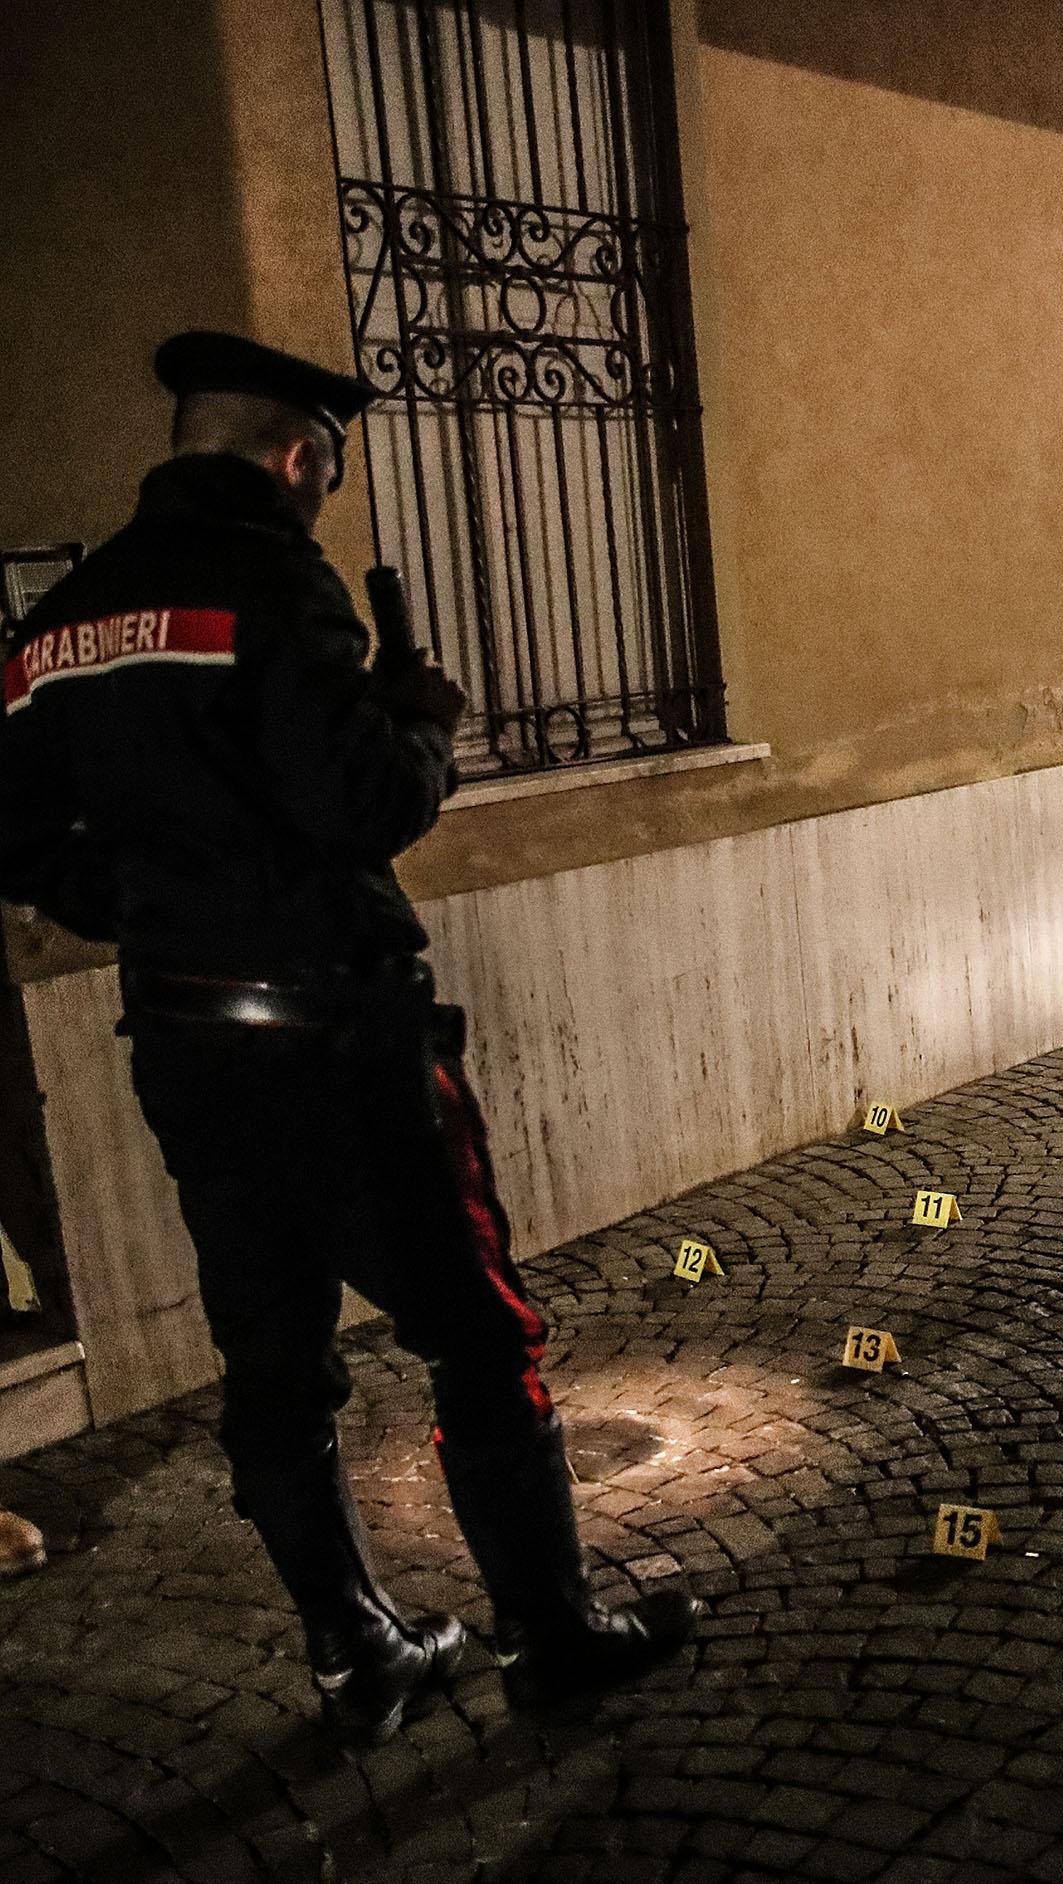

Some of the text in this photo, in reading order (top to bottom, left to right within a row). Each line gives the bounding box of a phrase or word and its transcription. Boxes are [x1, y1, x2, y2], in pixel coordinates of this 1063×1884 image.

[871, 1106, 887, 1127] 10
[920, 1196, 942, 1219] 11
[682, 1246, 701, 1272] 12
[852, 1334, 881, 1361] 13
[942, 1514, 981, 1547] 15
